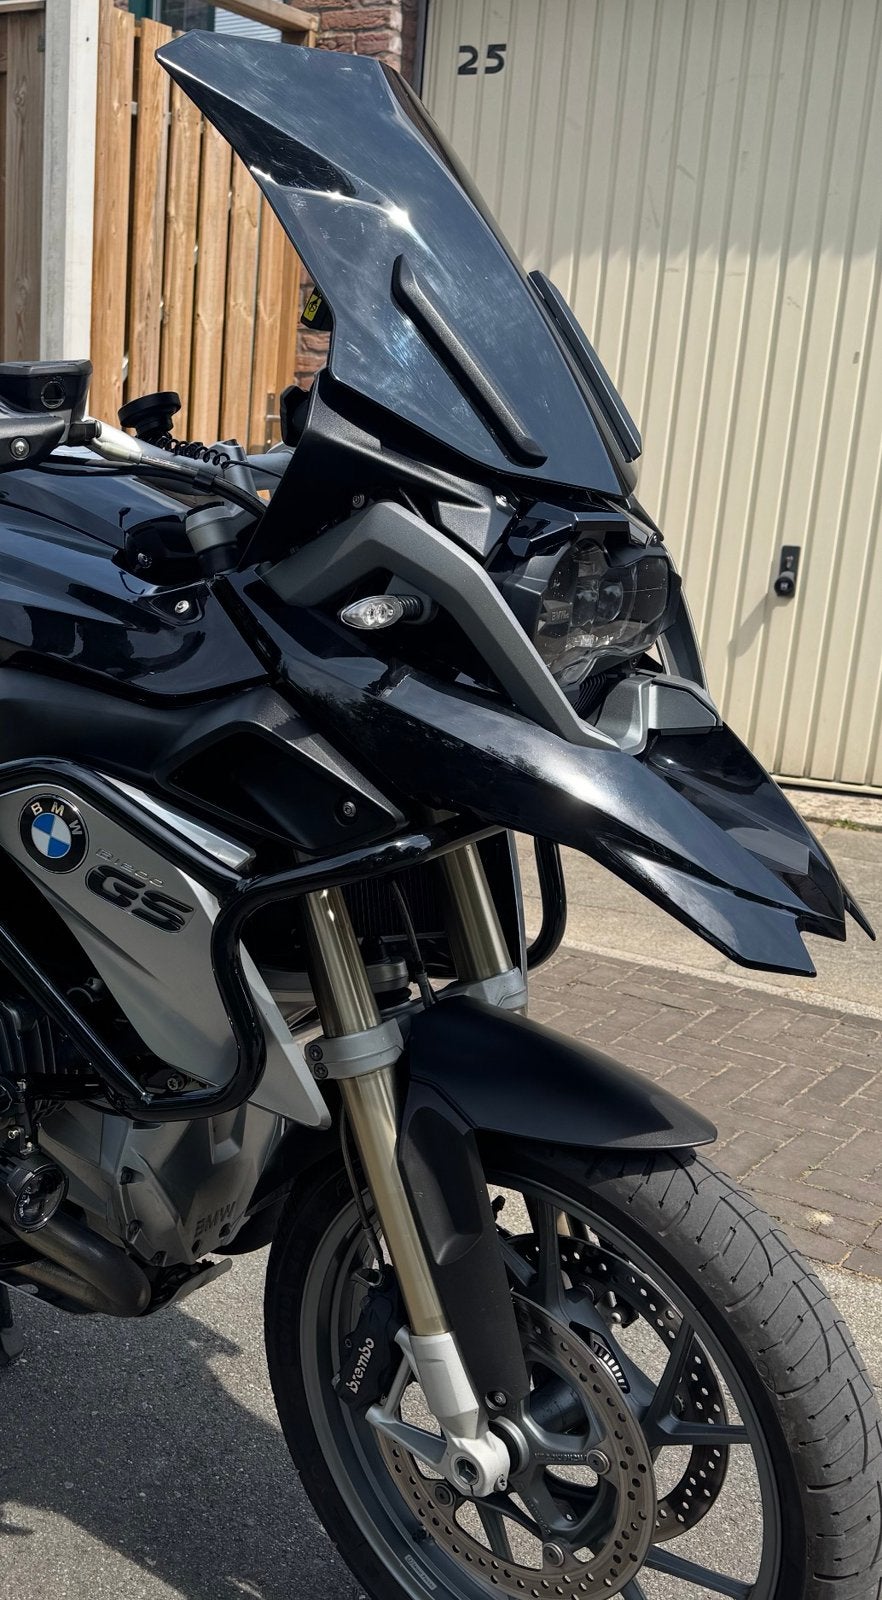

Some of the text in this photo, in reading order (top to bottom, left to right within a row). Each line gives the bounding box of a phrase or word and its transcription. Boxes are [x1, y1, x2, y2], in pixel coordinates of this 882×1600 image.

[457, 44, 507, 75] 25
[30, 801, 83, 836] BMW
[87, 865, 195, 932] GS
[194, 1200, 236, 1238] BMW
[345, 1337, 375, 1394] brembo
